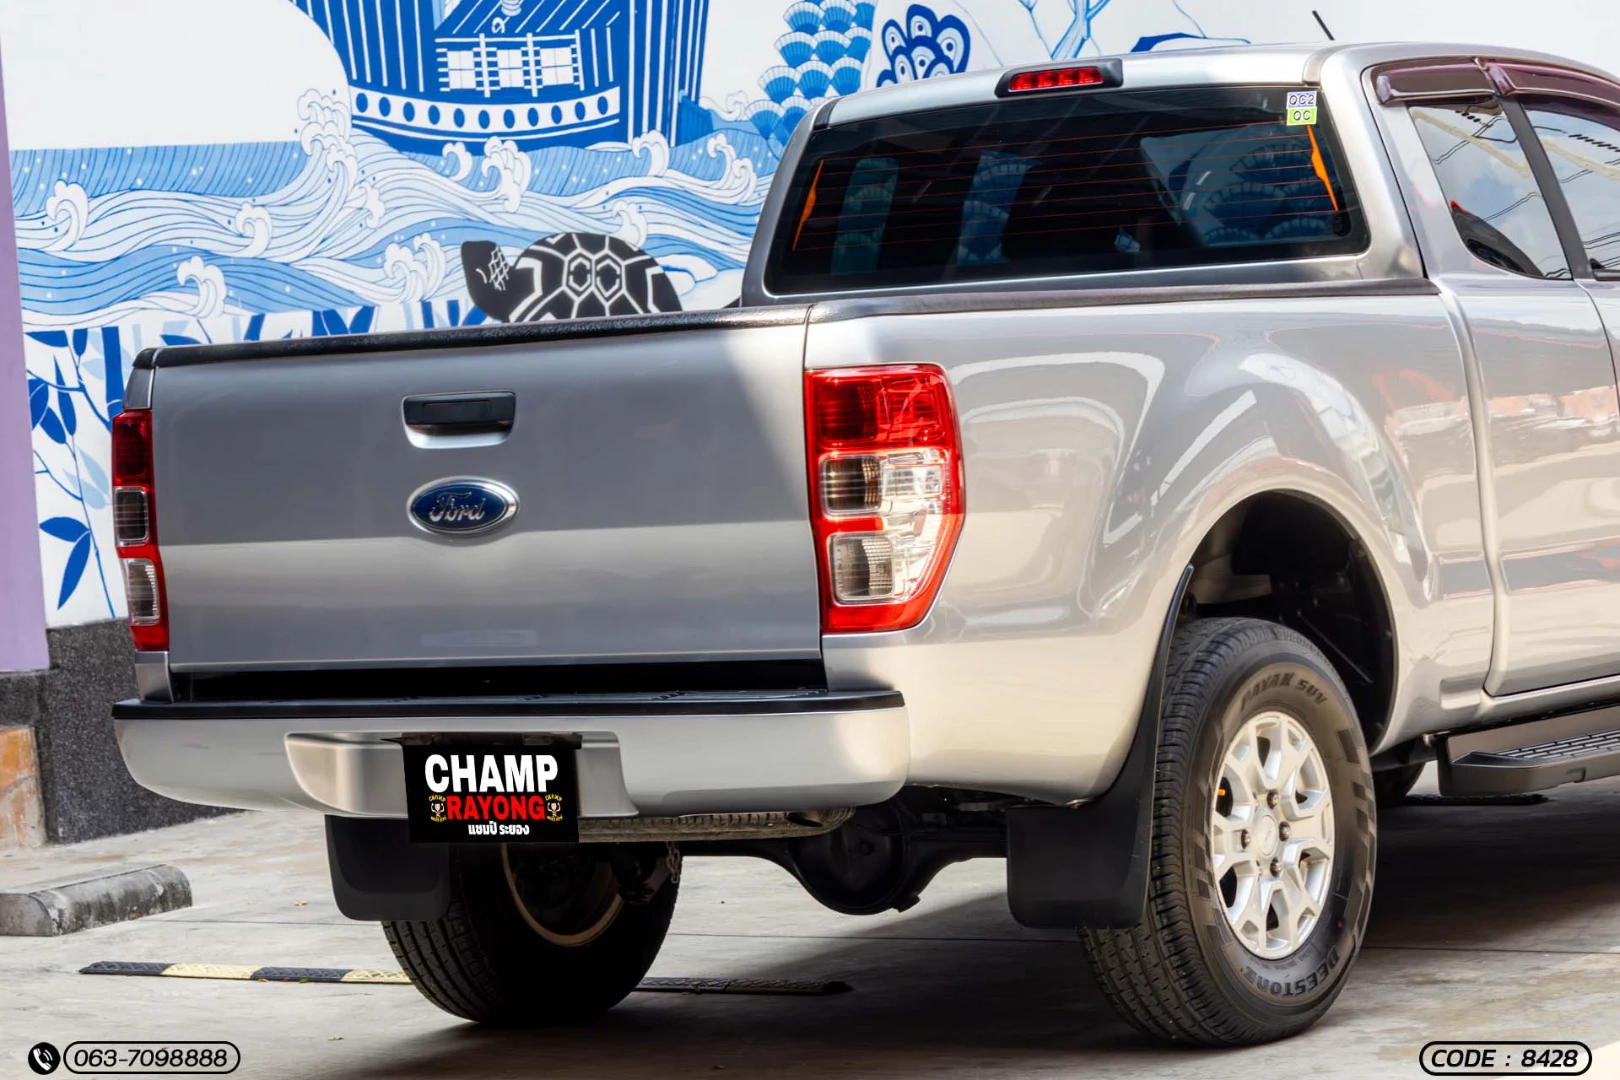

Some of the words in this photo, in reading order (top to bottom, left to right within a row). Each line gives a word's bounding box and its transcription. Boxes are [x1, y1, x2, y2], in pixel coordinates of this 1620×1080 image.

[428, 491, 486, 522] Ford
[1296, 679, 1328, 704] SUV
[1244, 945, 1340, 996] DEESTONE
